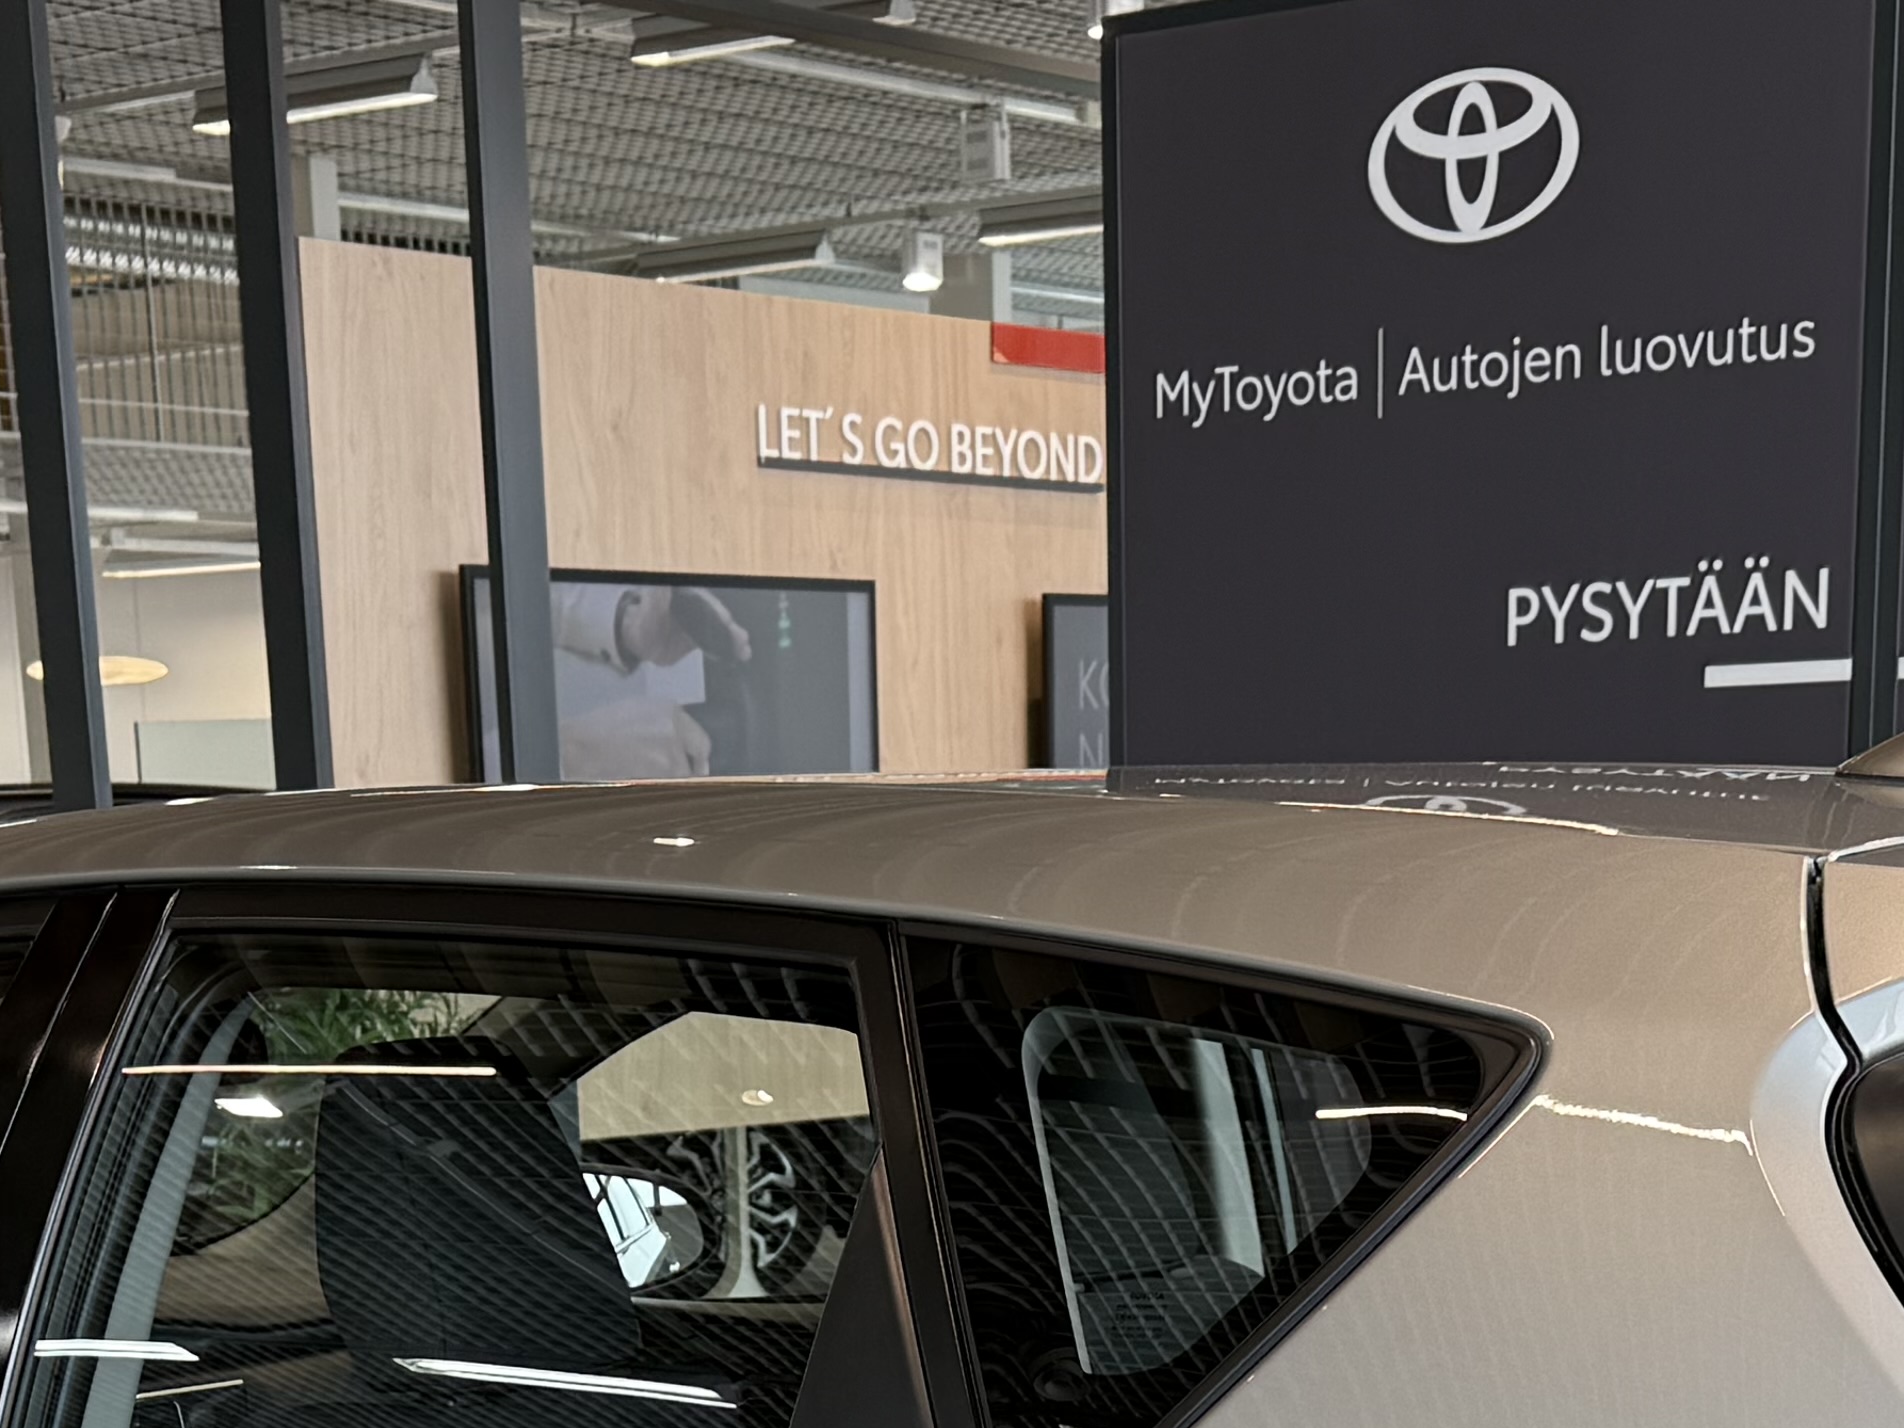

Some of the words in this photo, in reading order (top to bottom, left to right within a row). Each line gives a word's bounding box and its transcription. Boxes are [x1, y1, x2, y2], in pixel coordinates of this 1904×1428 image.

[1156, 360, 1358, 427] MyToyota
[1399, 337, 1581, 398] Autojen
[1600, 318, 1815, 377] luovutus
[875, 415, 939, 470] GO
[951, 423, 1102, 484] BEYOND
[1508, 556, 1830, 647] PYSYTÄÄN
